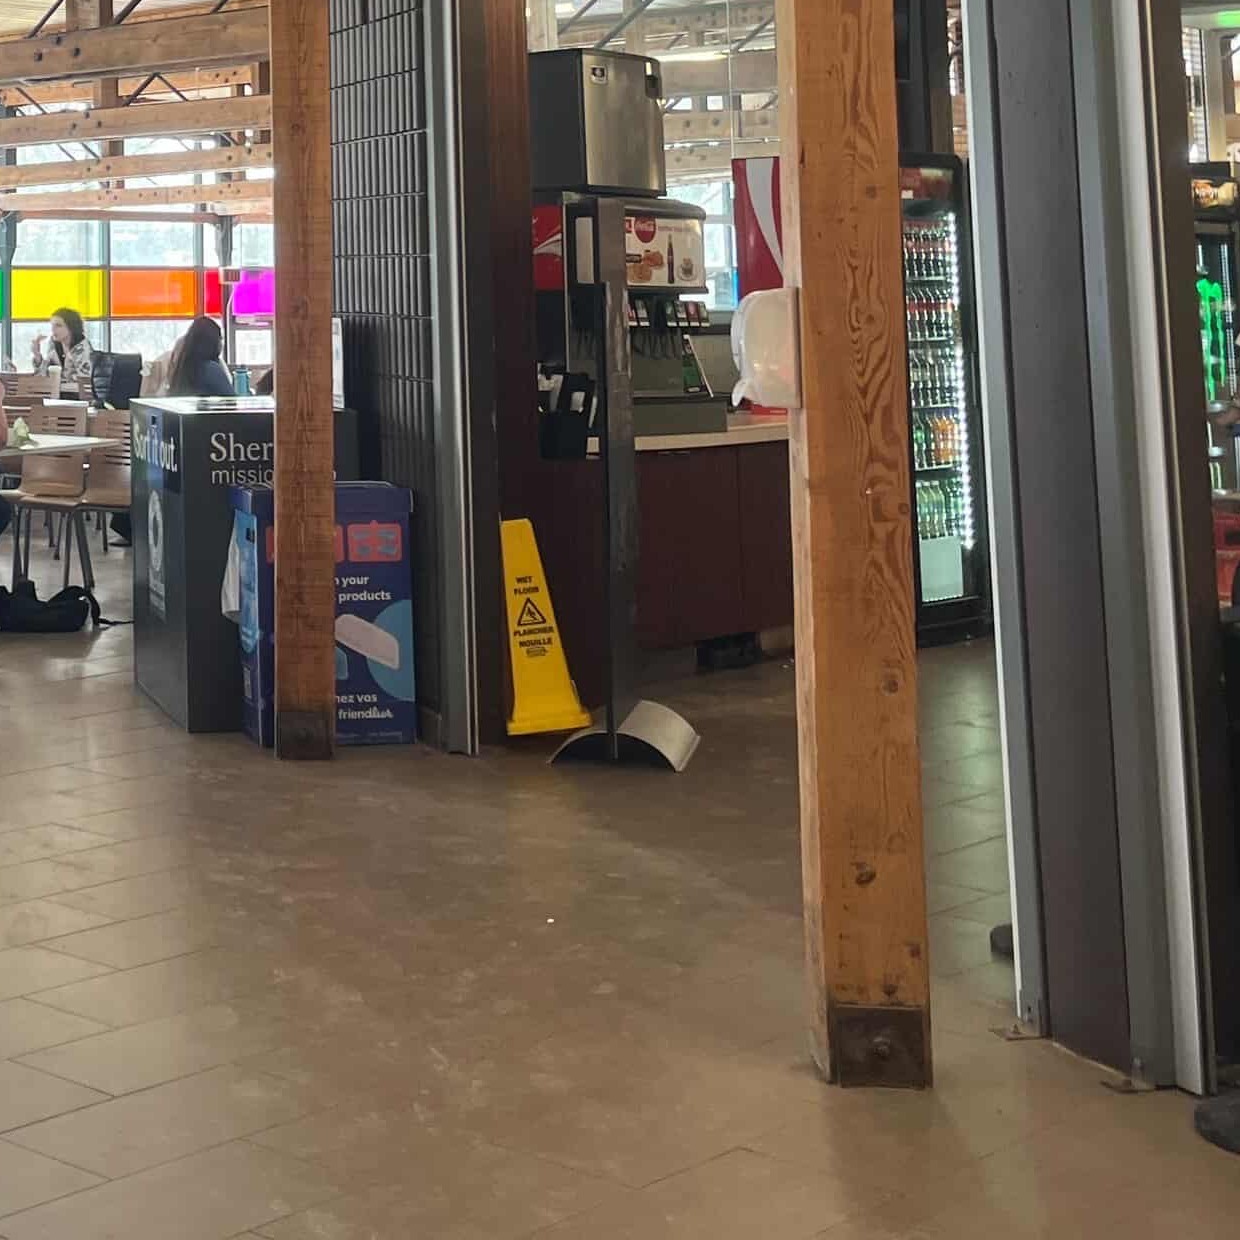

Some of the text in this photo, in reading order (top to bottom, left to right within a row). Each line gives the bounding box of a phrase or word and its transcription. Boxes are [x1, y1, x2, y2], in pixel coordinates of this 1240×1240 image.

[209, 432, 274, 462] Sher
[211, 464, 274, 485] missio
[341, 576, 369, 587] your
[339, 590, 392, 604] products
